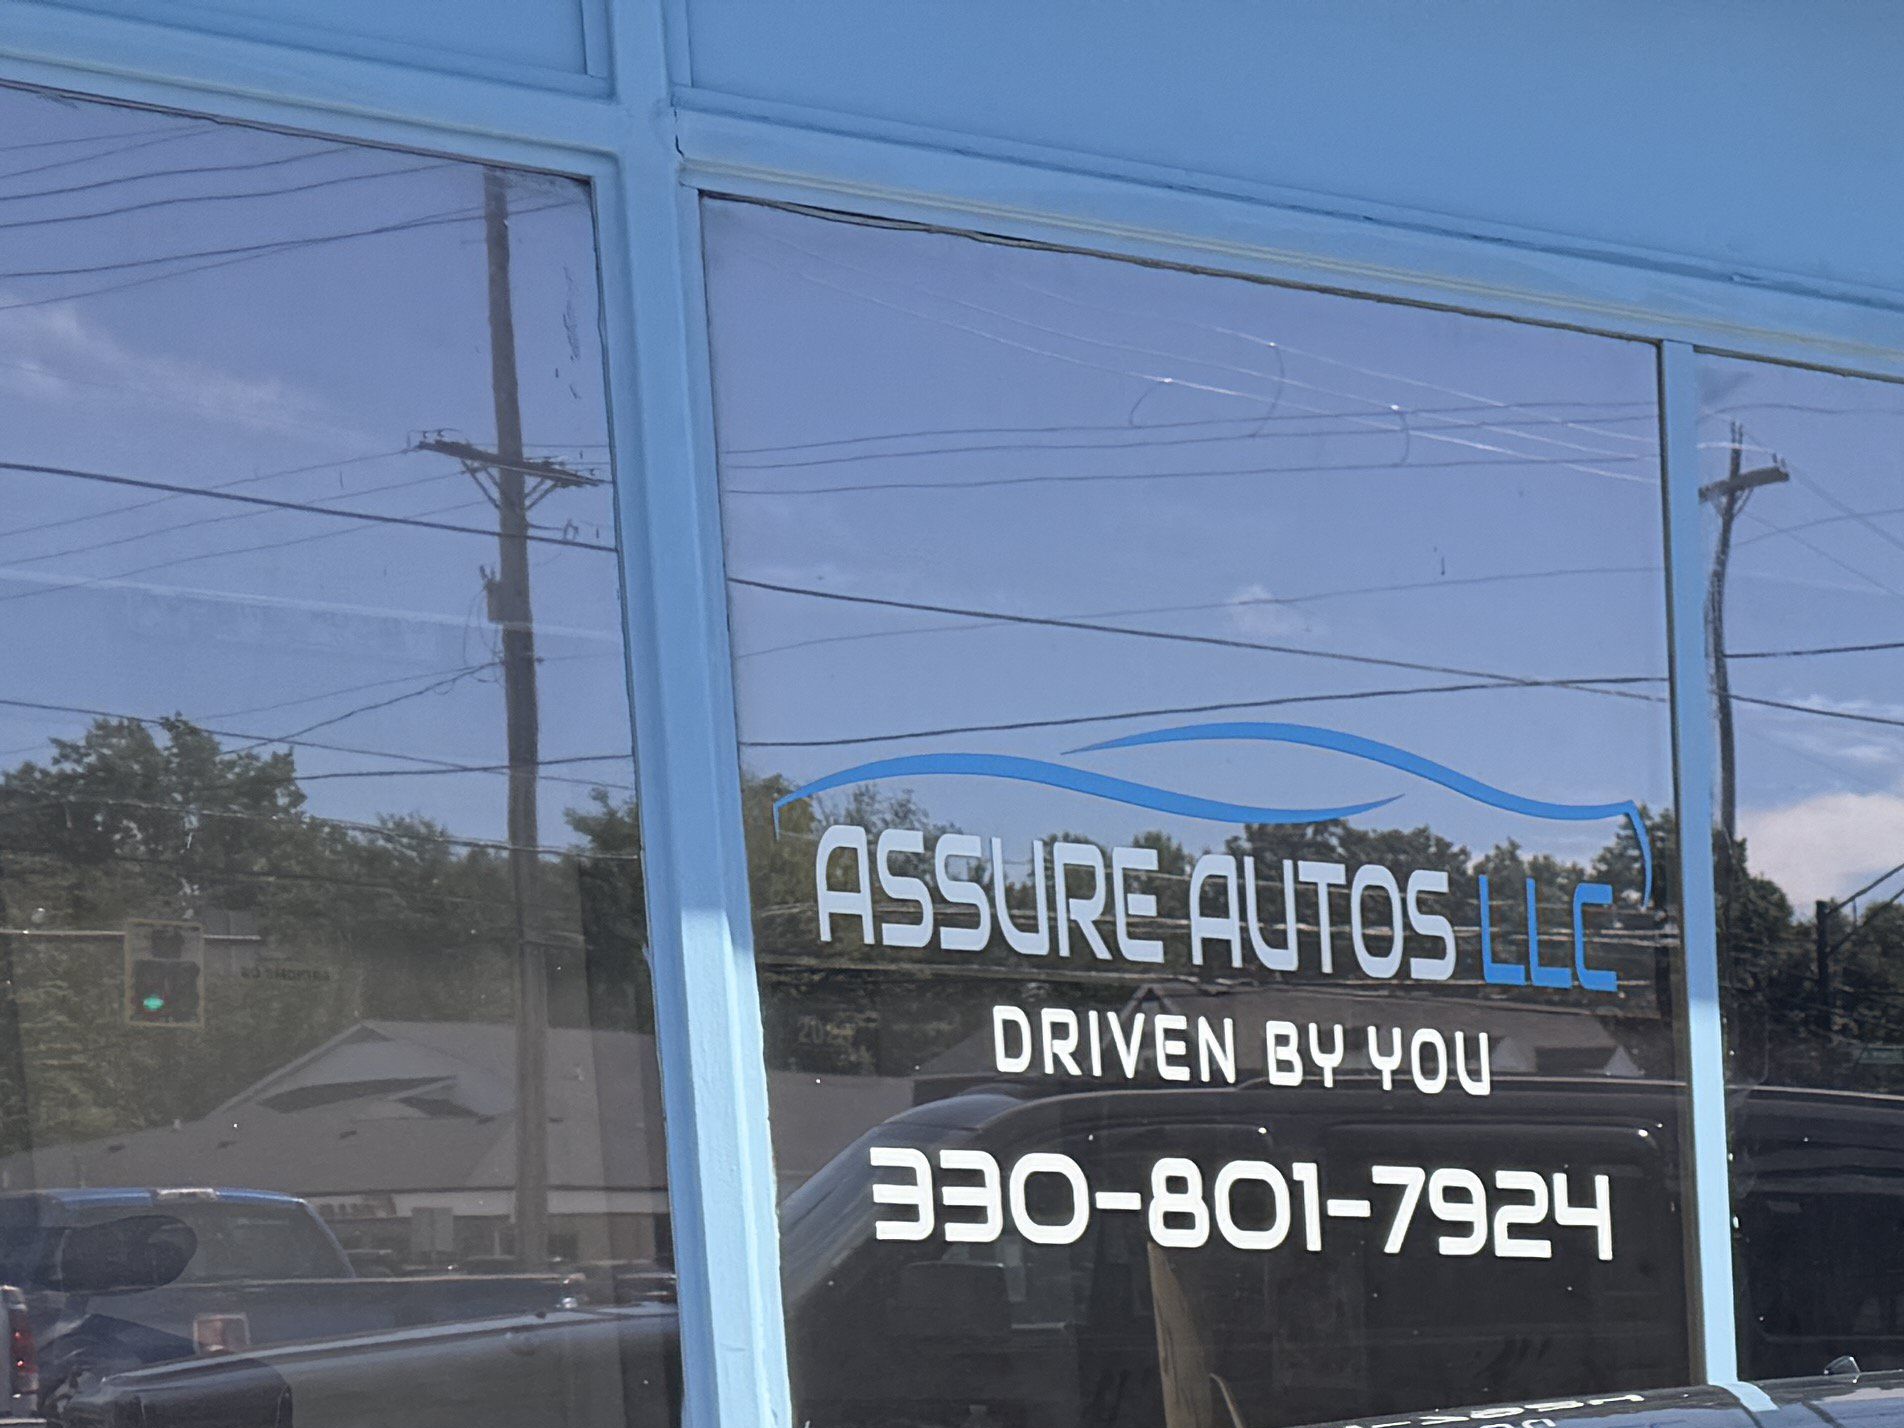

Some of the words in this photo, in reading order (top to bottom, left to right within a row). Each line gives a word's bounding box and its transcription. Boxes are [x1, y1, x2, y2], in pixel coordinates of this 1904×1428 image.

[816, 824, 1163, 965] ASSURE
[1189, 853, 1457, 982] AUTOS
[1478, 875, 1618, 992] LLC
[993, 1004, 1237, 1086] DRIVEN
[1266, 1020, 1344, 1089] BY
[1368, 1025, 1492, 1097] YOU
[869, 1145, 1613, 1262] 330-801-7924
